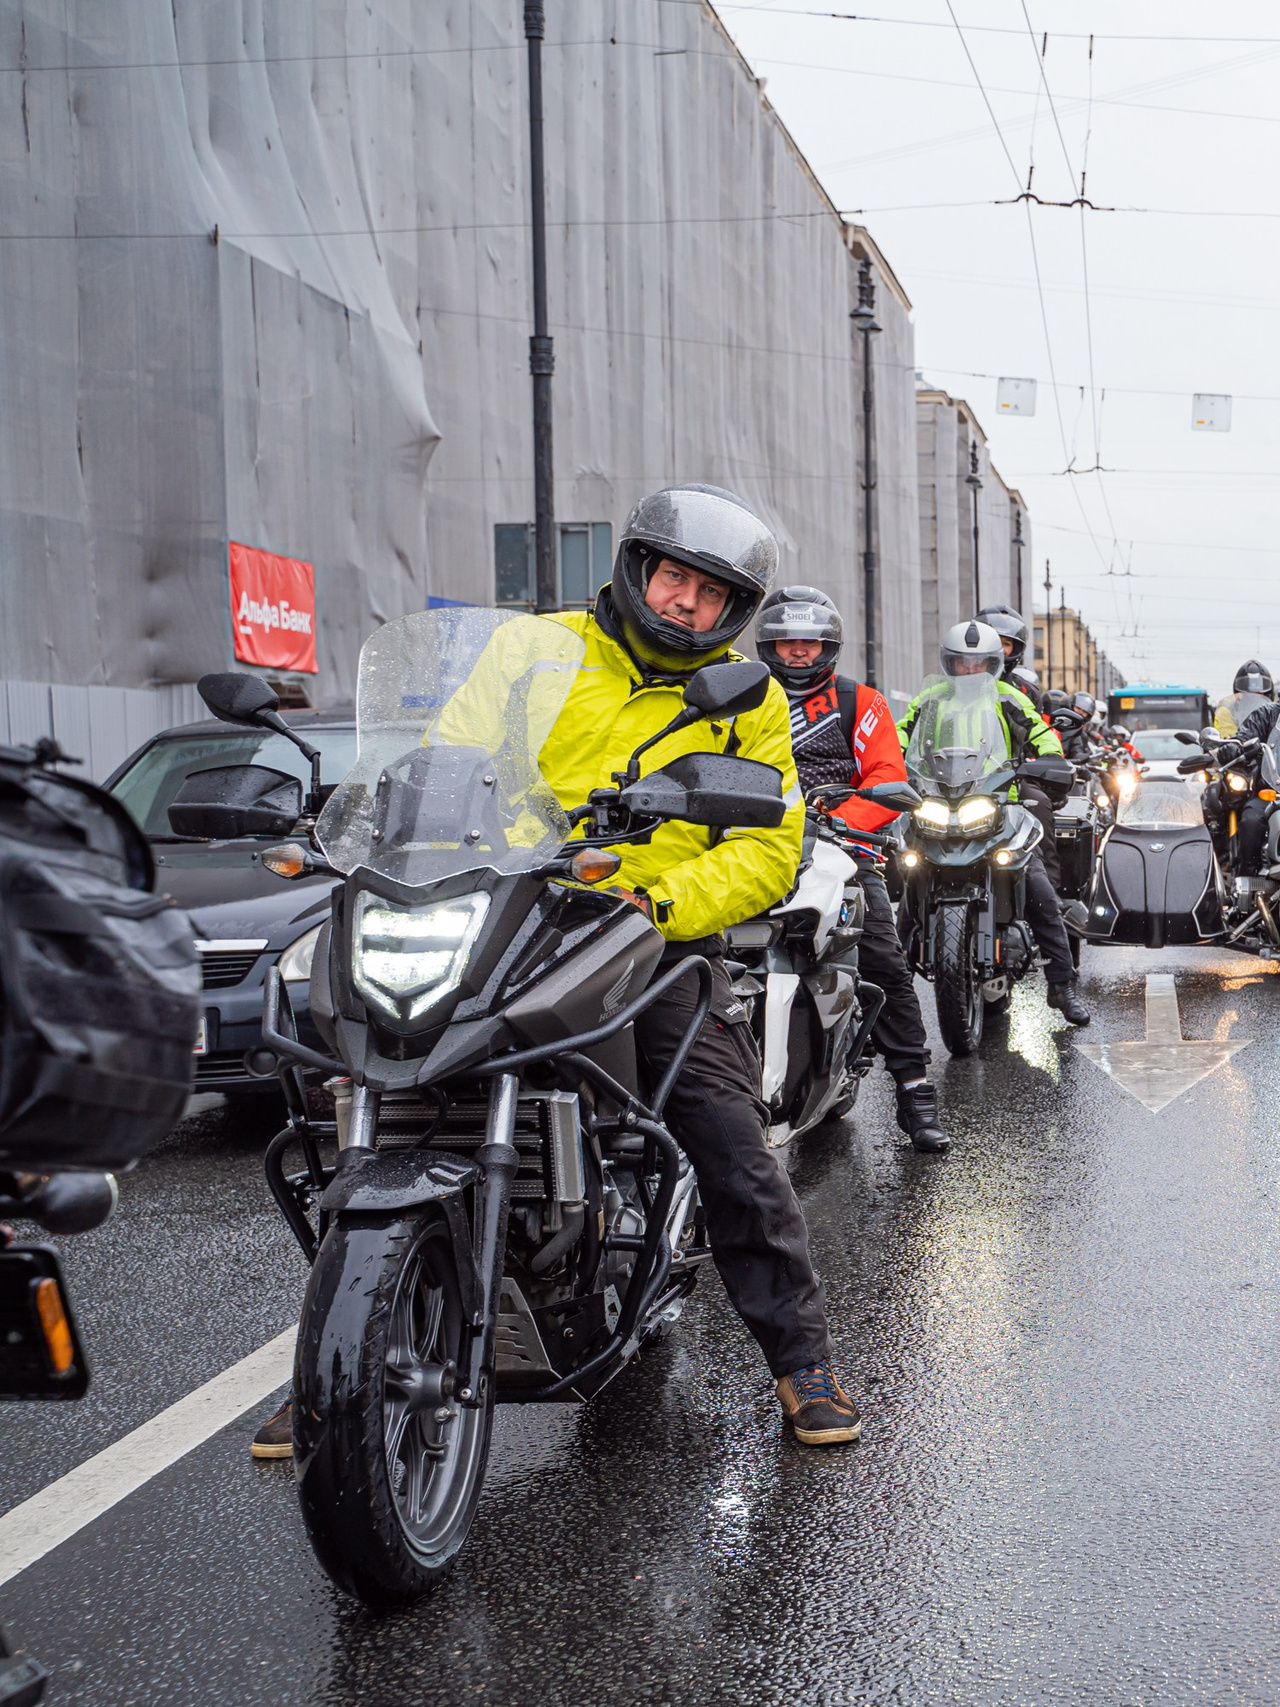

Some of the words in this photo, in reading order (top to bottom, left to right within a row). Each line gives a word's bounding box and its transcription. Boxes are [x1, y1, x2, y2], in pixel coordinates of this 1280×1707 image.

[237, 590, 280, 634] Альфа
[279, 599, 312, 634] Банк
[786, 613, 811, 621] SHOEI
